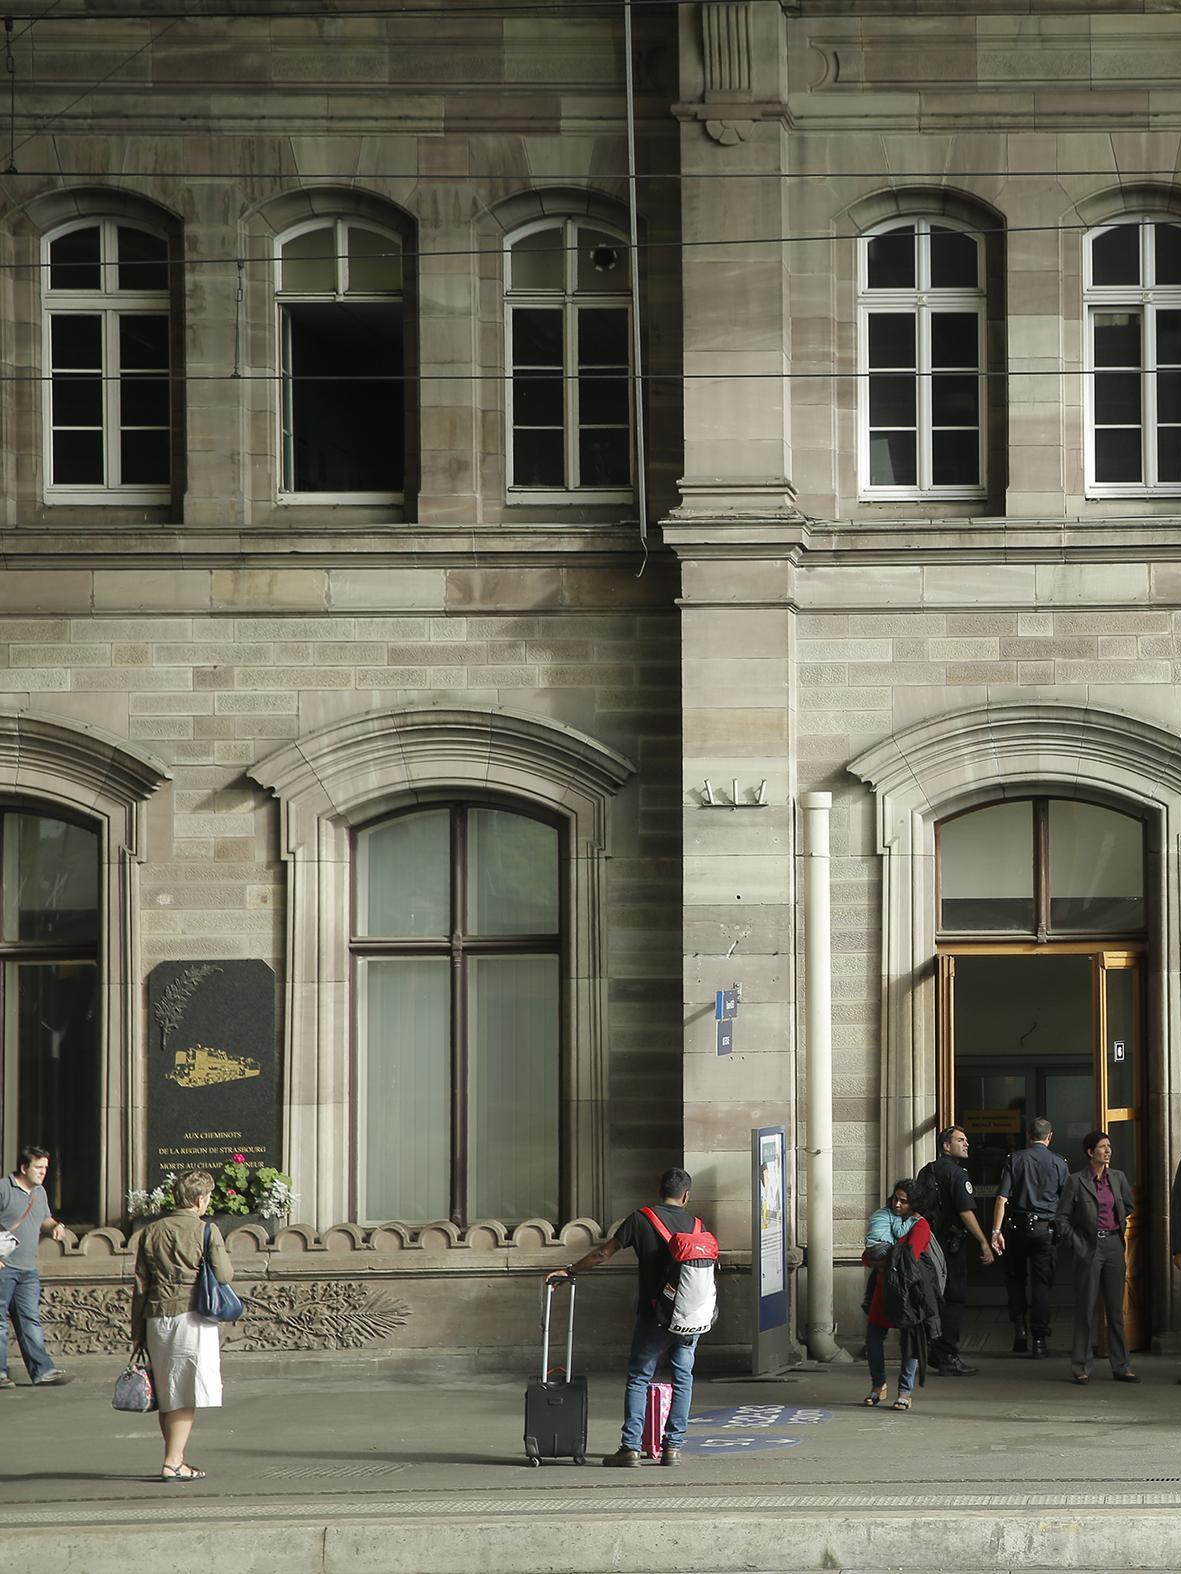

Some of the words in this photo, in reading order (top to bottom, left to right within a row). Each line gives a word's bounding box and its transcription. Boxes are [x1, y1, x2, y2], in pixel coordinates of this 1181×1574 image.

[184, 1132, 200, 1140] AUX
[200, 1131, 242, 1139] CHEMINOTS
[158, 1147, 169, 1155] DE
[169, 1147, 180, 1155] LA
[208, 1146, 219, 1154] DE
[219, 1145, 267, 1153] STRASBOURG
[160, 1162, 185, 1170] MORTS
[196, 1161, 223, 1169] CHAMP
